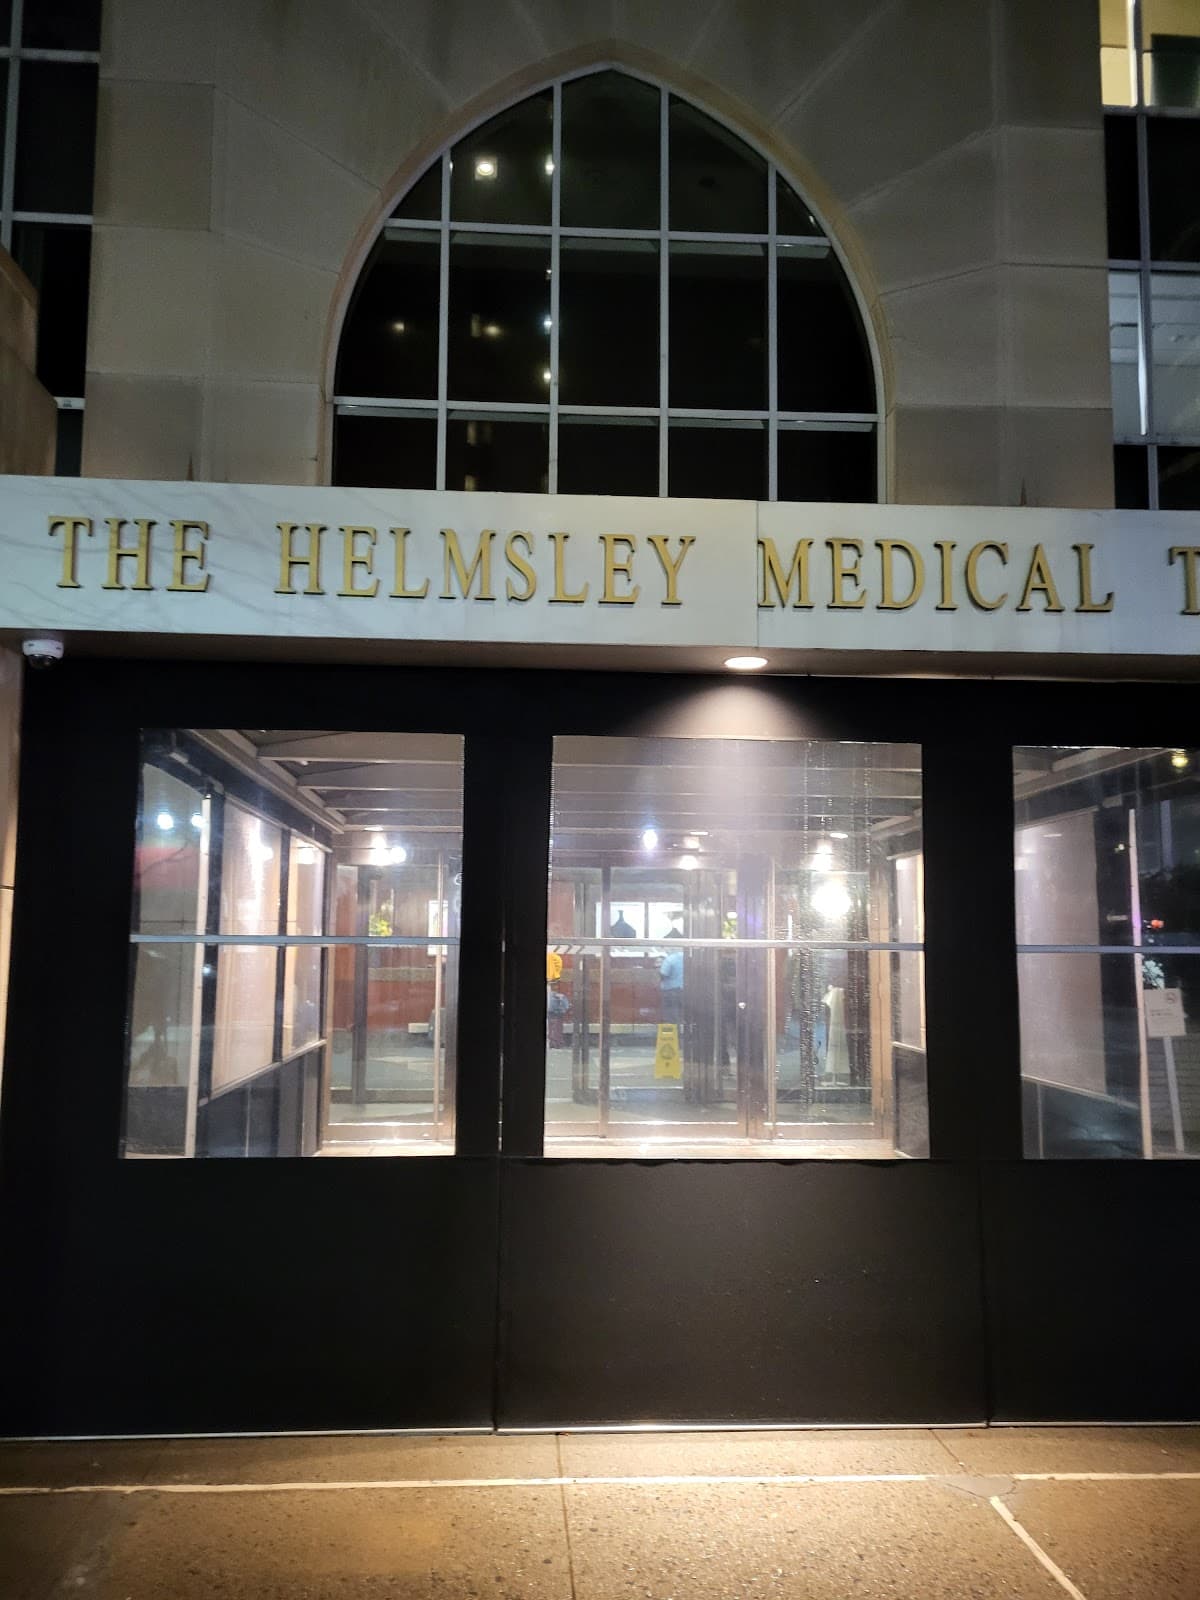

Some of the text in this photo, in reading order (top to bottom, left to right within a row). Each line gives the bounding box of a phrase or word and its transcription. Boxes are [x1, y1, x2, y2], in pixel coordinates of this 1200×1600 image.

[48, 516, 211, 592] THE
[274, 522, 696, 605] HELMSLEY
[757, 537, 1114, 612] MEDICAL
